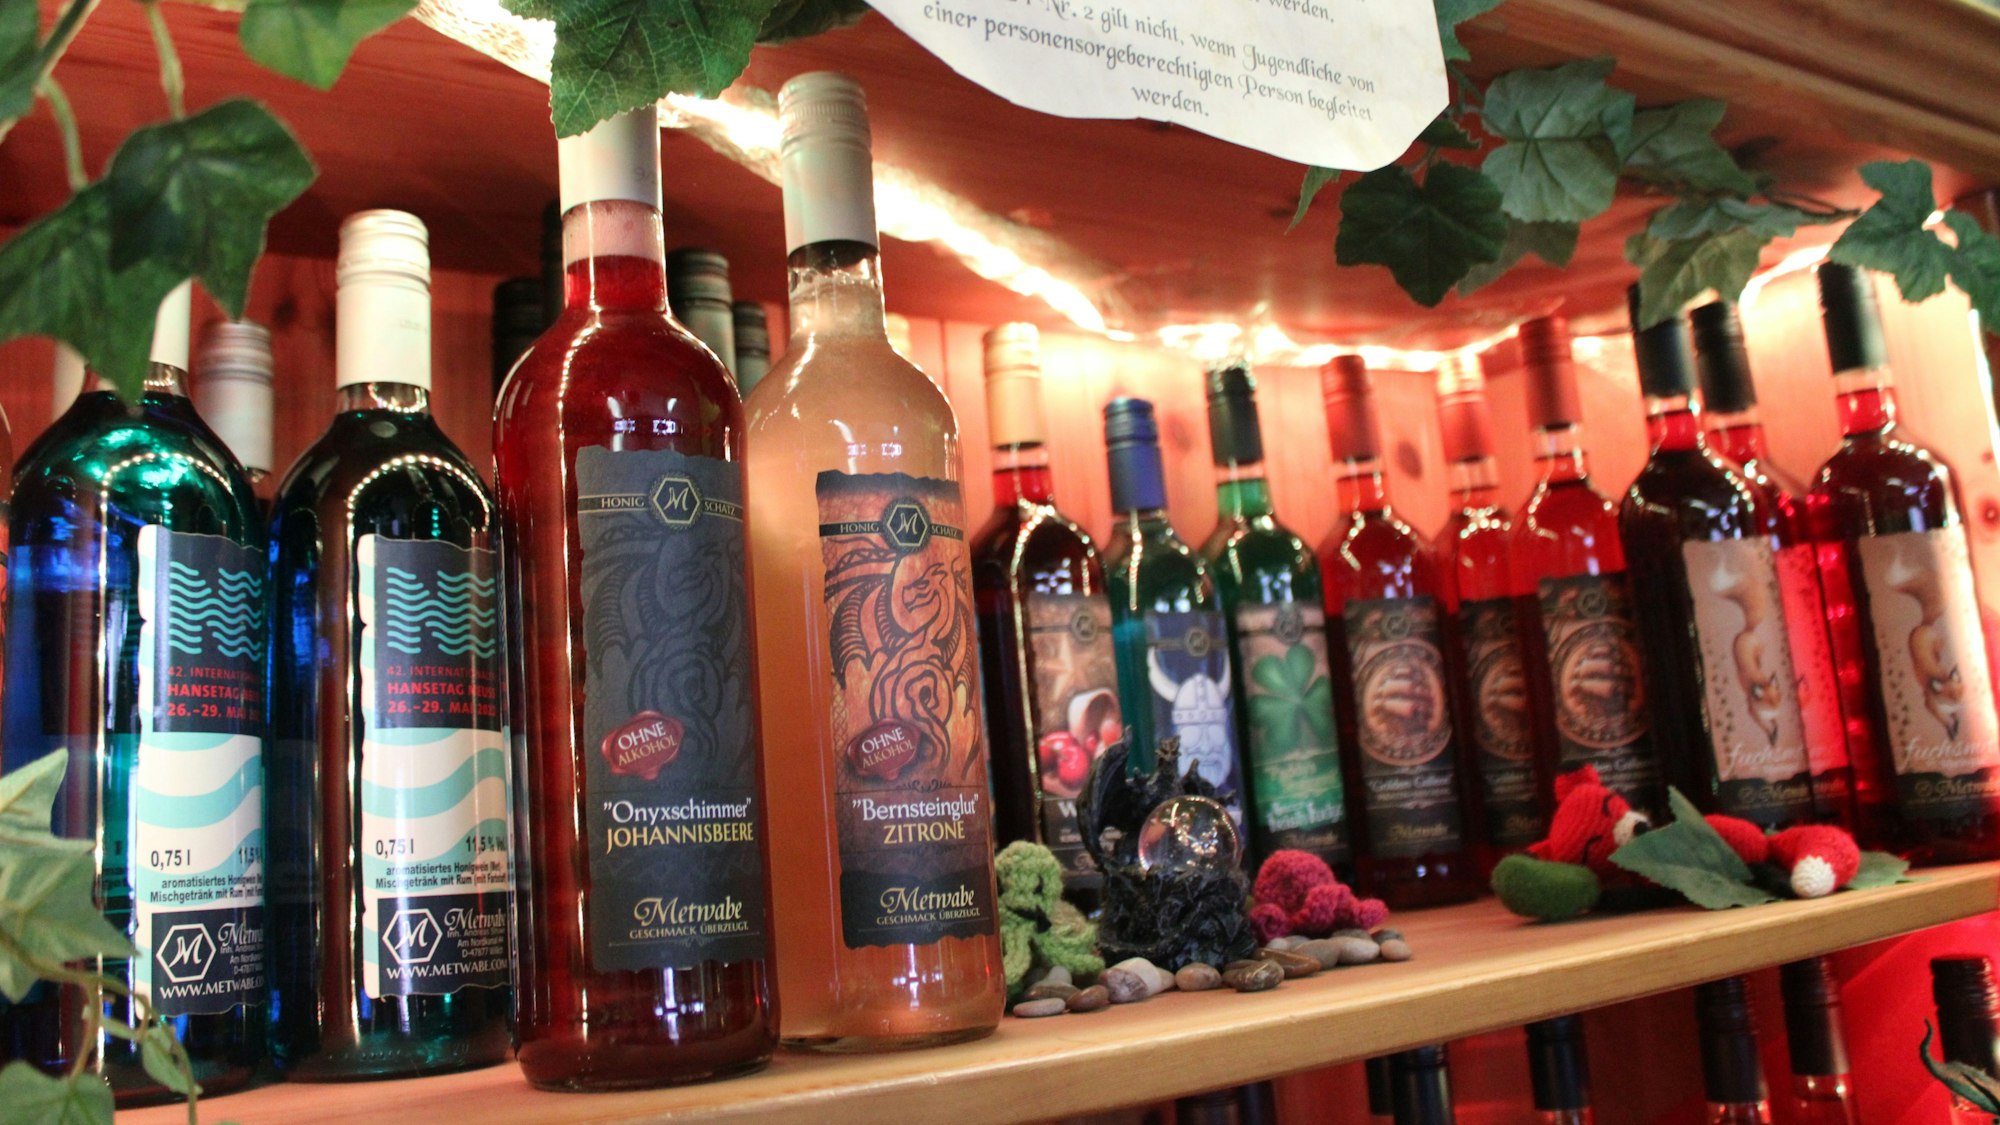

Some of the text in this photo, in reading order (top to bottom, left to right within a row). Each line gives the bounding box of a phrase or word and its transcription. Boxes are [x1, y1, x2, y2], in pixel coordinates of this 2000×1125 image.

[1084, 6, 1095, 20] 2
[1101, 8, 1128, 33] gilt
[1135, 17, 1184, 46] nicht,
[1190, 33, 1236, 58] wenn
[1242, 43, 1343, 85] Jugendliche
[1347, 75, 1375, 93] von
[923, 2, 1373, 121] einer personensorgeberechtigten Person begleitet
[1132, 82, 1210, 118] werden.
[601, 496, 736, 517] HONIG SCHATZ
[840, 522, 880, 534] HONIG
[167, 683, 240, 700] HANSETAG
[387, 682, 465, 696] HANSETAG
[617, 721, 667, 751] OHNE
[861, 727, 906, 754] OHNE
[618, 734, 678, 767] ALKOHOL
[862, 739, 914, 769] ALKOHOL
[606, 821, 754, 855] JOHANNISBEERE
[883, 820, 966, 845] ZITRONE
[376, 839, 406, 859] 0,75
[151, 850, 182, 870] 0,75
[161, 873, 226, 889] aromatisiertes
[440, 875, 454, 885] mit
[456, 874, 472, 885] Rum
[150, 889, 214, 904] Mischgetränk
[216, 888, 227, 899] mit
[879, 884, 975, 914] Metwabe
[634, 895, 743, 927] Metwabe
[876, 912, 937, 926] GESCHMACK
[629, 925, 697, 940] GESCHMACK
[457, 938, 469, 949] Am
